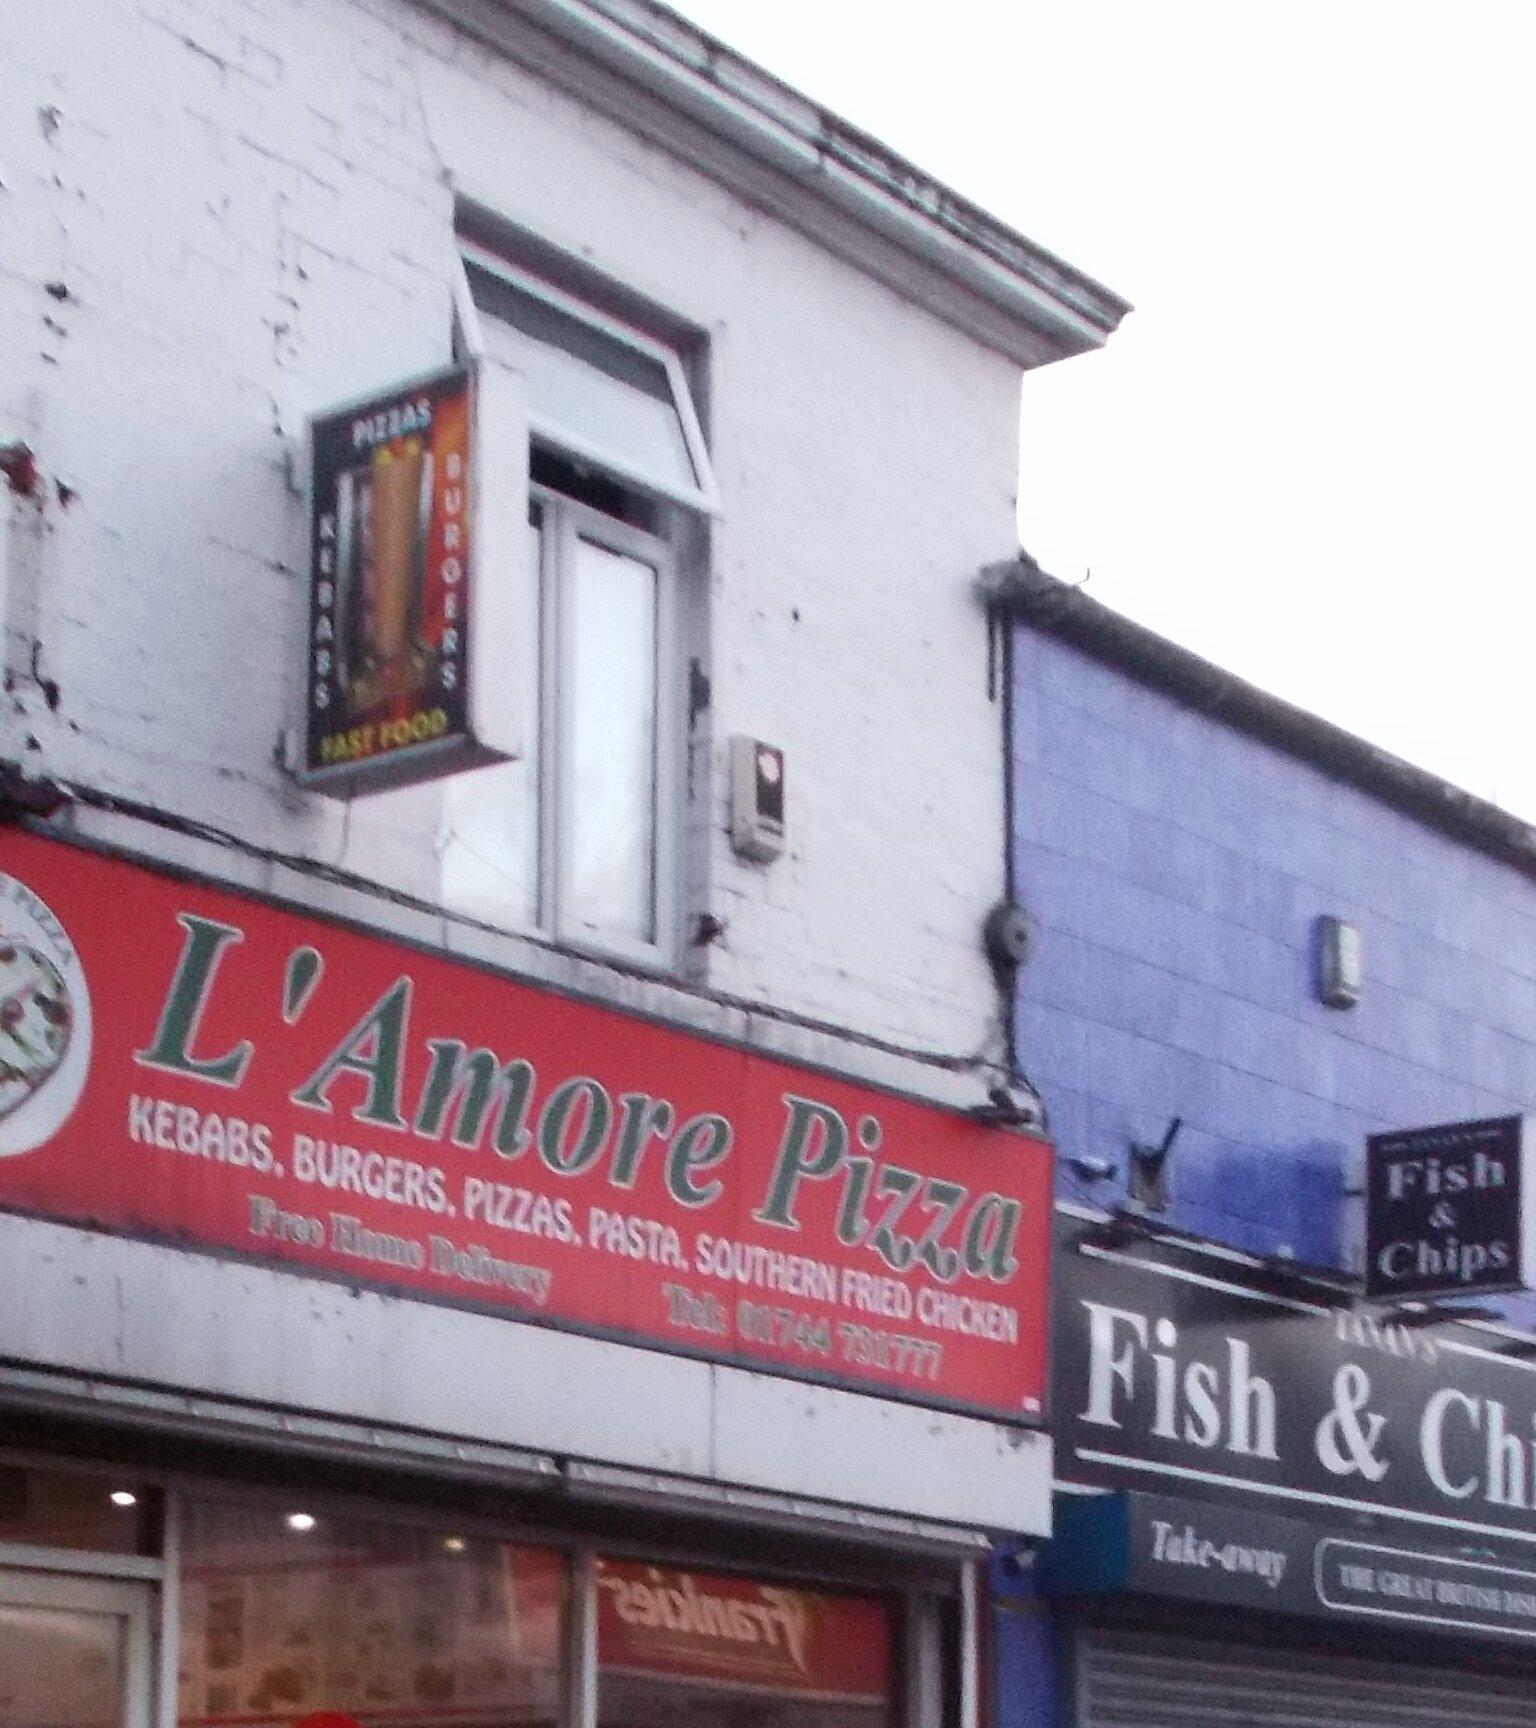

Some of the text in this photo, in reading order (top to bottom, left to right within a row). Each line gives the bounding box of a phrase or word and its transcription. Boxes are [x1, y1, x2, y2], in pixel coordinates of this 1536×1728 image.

[438, 451, 464, 692] BURGERS
[315, 513, 335, 709] KEBABS
[321, 706, 447, 761] FAST FOOD
[133, 911, 1021, 1284] L'Amore Pizza
[1386, 1151, 1506, 1200] Fish
[247, 1193, 325, 1249] Free
[329, 1211, 425, 1271] Home
[1427, 1200, 1457, 1230] &
[695, 1233, 838, 1303] SOUTHERN
[841, 1266, 913, 1321] FRIED
[916, 1286, 1020, 1346] CHICKEN
[1377, 1237, 1510, 1282] Chips
[1076, 1298, 1281, 1462] Fish
[1315, 1363, 1390, 1483] &
[1151, 1519, 1287, 1589] Take-away
